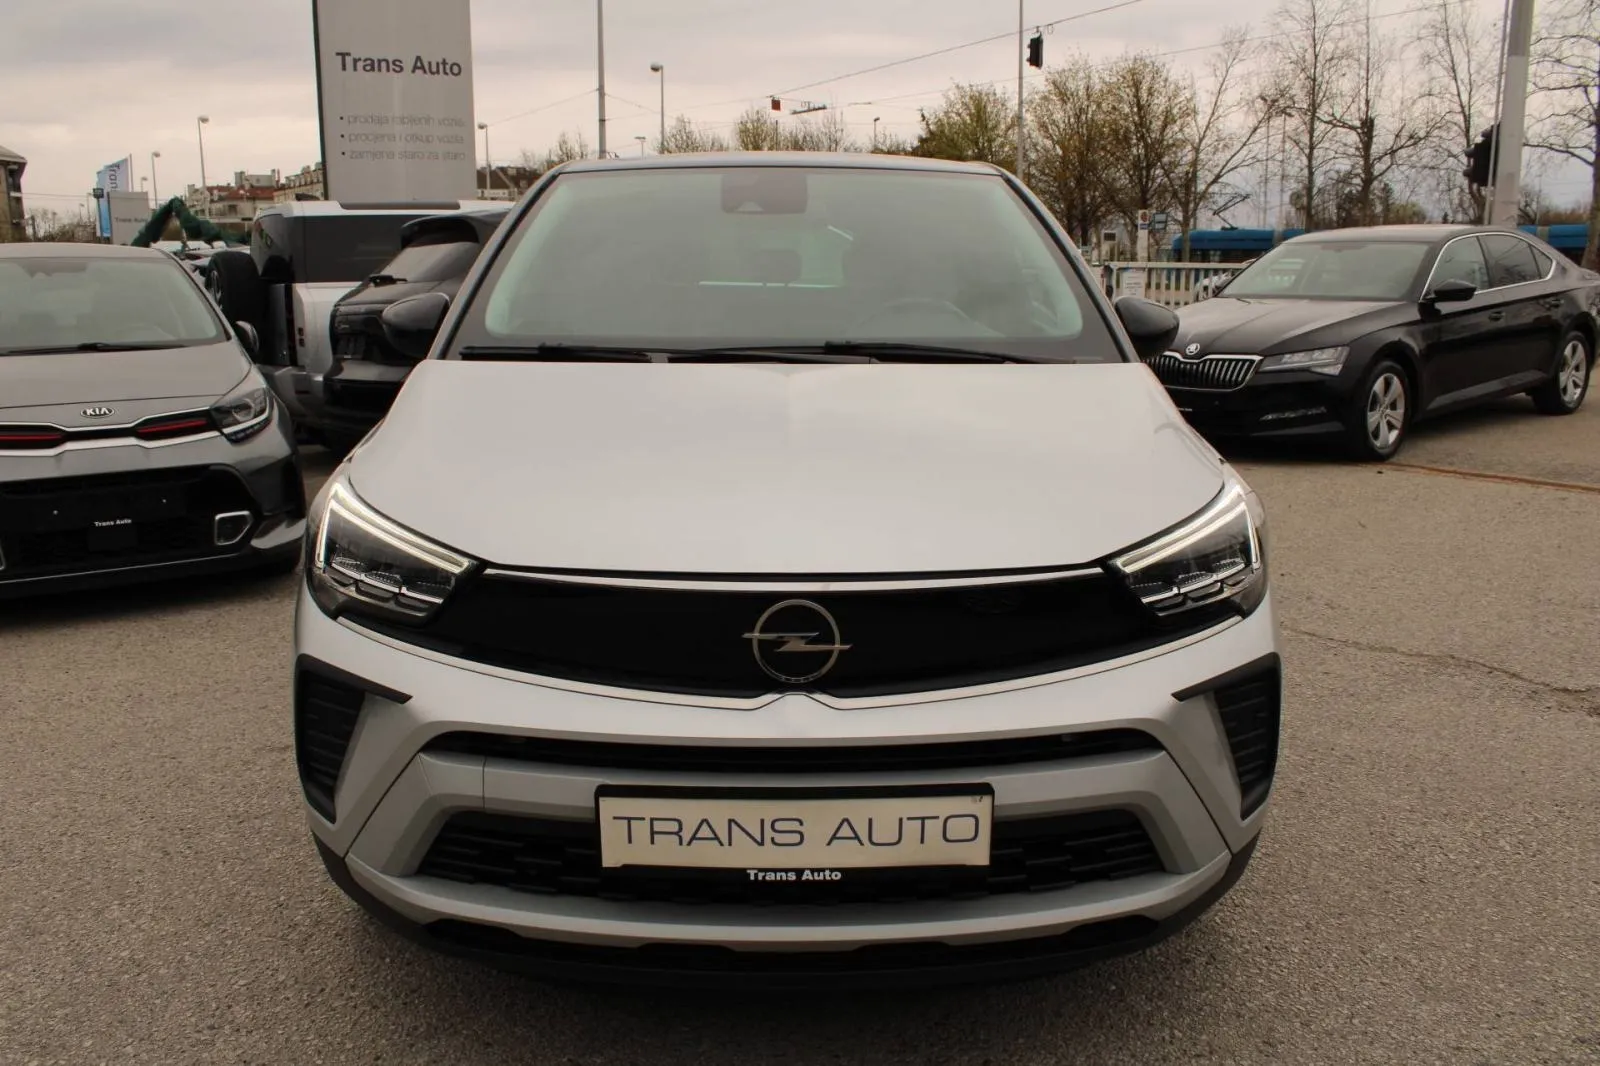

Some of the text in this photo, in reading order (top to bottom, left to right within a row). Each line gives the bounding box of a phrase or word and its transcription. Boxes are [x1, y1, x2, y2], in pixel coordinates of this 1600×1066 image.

[335, 52, 462, 77] Trans Auto
[86, 407, 110, 416] KIA
[612, 813, 980, 847] TRANS AUTO
[746, 869, 842, 881] Trans Auto
